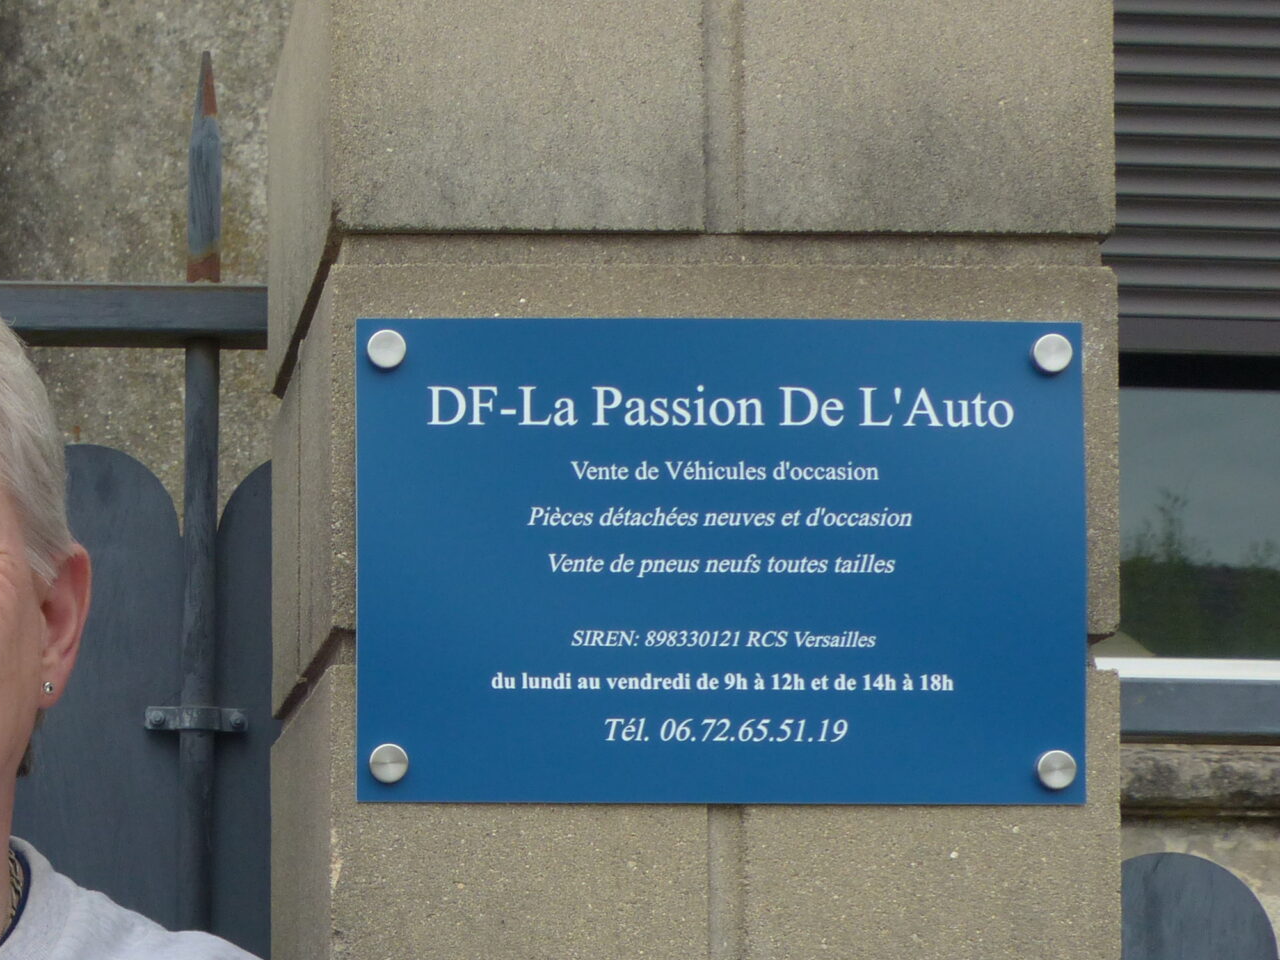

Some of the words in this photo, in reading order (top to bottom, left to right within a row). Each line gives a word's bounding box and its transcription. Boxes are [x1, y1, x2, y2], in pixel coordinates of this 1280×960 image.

[426, 384, 579, 427] DF-La
[591, 384, 766, 427] Passion
[778, 385, 845, 427] De
[858, 386, 1015, 429] L'Auto
[570, 460, 630, 481] Vente
[634, 460, 660, 481] de
[664, 460, 768, 481] Véhicules
[772, 460, 880, 481] d'occasion
[526, 506, 594, 527] Pièces
[598, 506, 699, 527] détachées
[702, 511, 777, 527] neuves
[780, 509, 802, 527] et
[805, 506, 913, 528] d'occasion
[548, 552, 605, 573] Vente
[609, 552, 636, 573] de
[636, 558, 701, 579] pneus
[703, 553, 762, 574] neufs
[767, 556, 829, 574] toutes
[834, 553, 896, 574] tailles
[570, 629, 640, 647] SIREN:
[644, 629, 741, 648] 898330121
[745, 629, 789, 648] RCS
[793, 630, 877, 648] Versailles
[490, 671, 516, 690] du
[521, 671, 573, 690] lundi
[576, 676, 601, 690] au
[605, 672, 692, 691] vendredi
[695, 672, 720, 691] de
[723, 672, 749, 691] 9h
[753, 672, 766, 691] à
[770, 672, 806, 691] 12h
[810, 674, 830, 691] et
[833, 673, 857, 692] de
[862, 673, 897, 692] 14h
[901, 673, 914, 692] à
[919, 673, 954, 692] 18h
[604, 717, 650, 742] Tél.
[659, 717, 849, 743] 06.72.65.51.19
